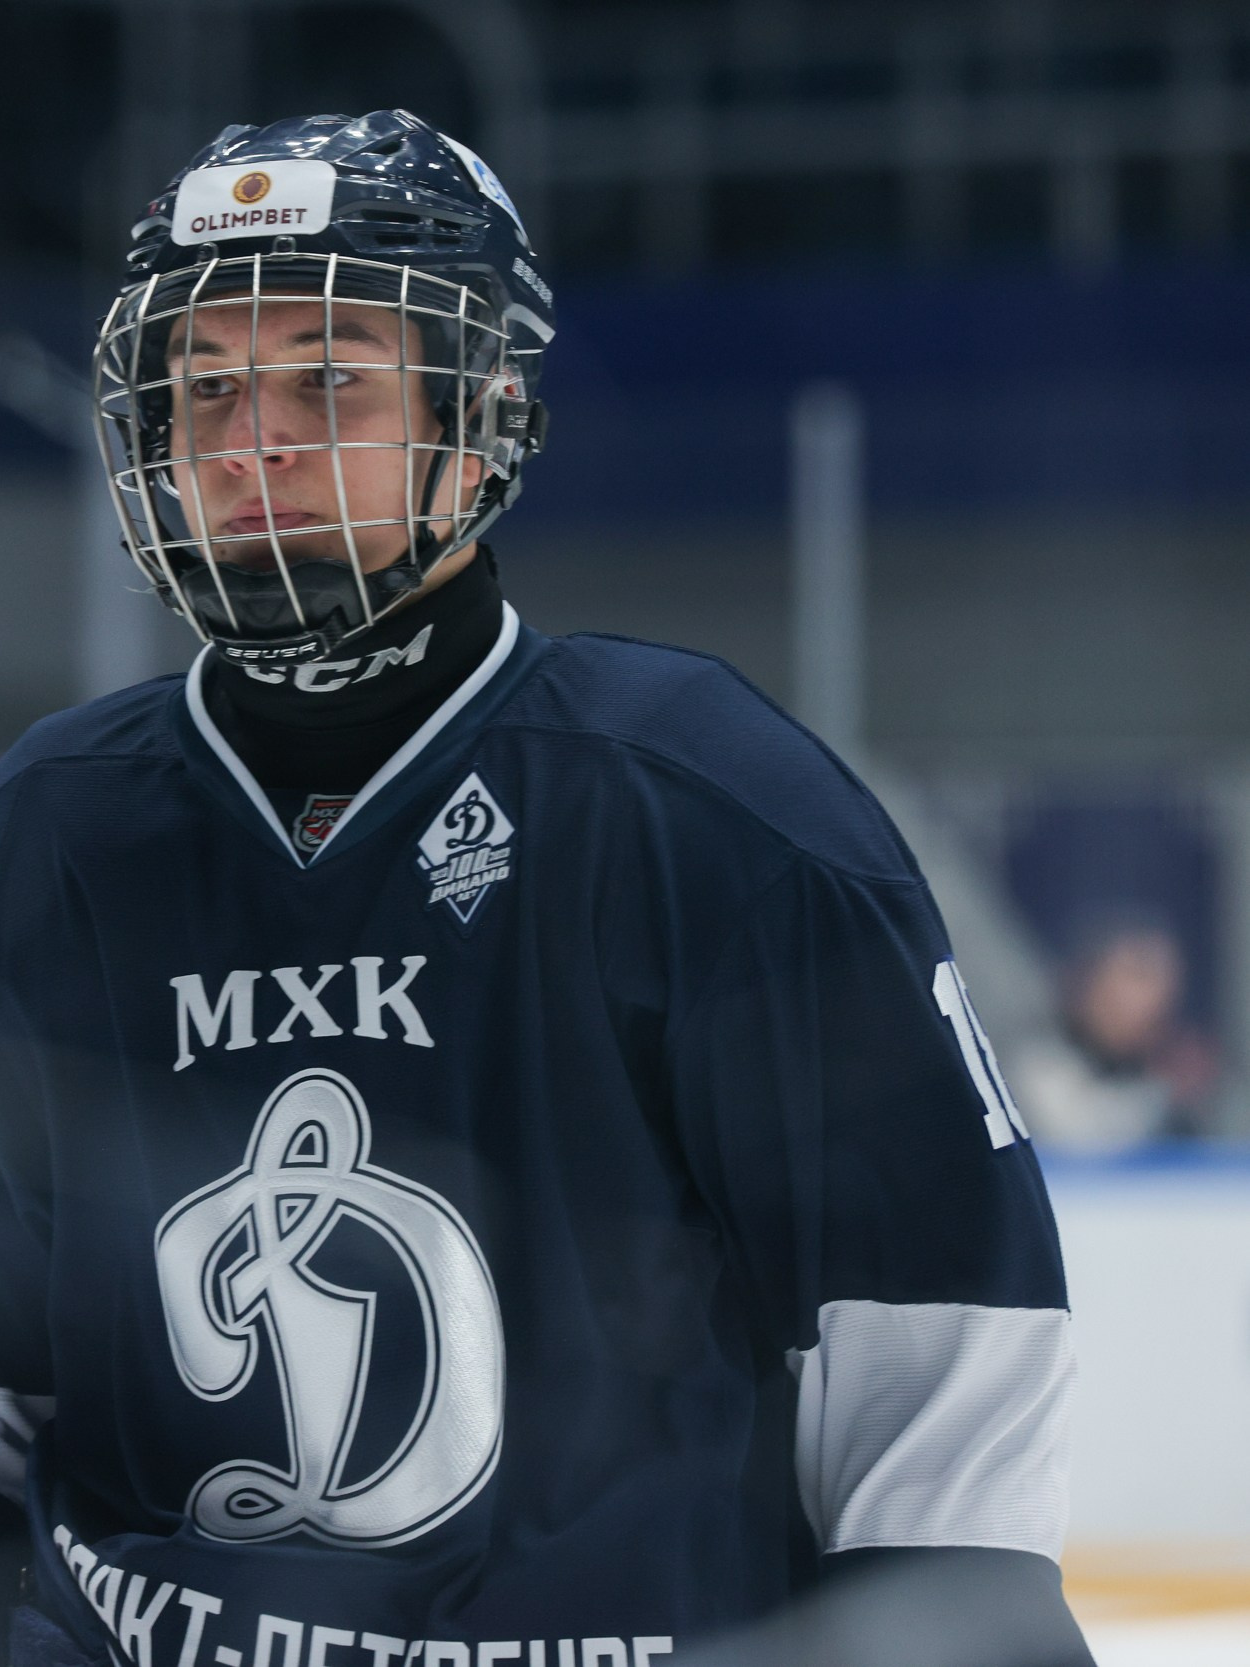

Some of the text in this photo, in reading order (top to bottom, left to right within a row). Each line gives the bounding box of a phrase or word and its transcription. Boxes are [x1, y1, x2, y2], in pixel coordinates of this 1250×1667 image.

[191, 208, 307, 234] OLIMPBET
[225, 641, 318, 660] BAUER
[448, 846, 492, 883] 100
[428, 865, 510, 904] ДИНАМО
[169, 955, 435, 1072] МХК
